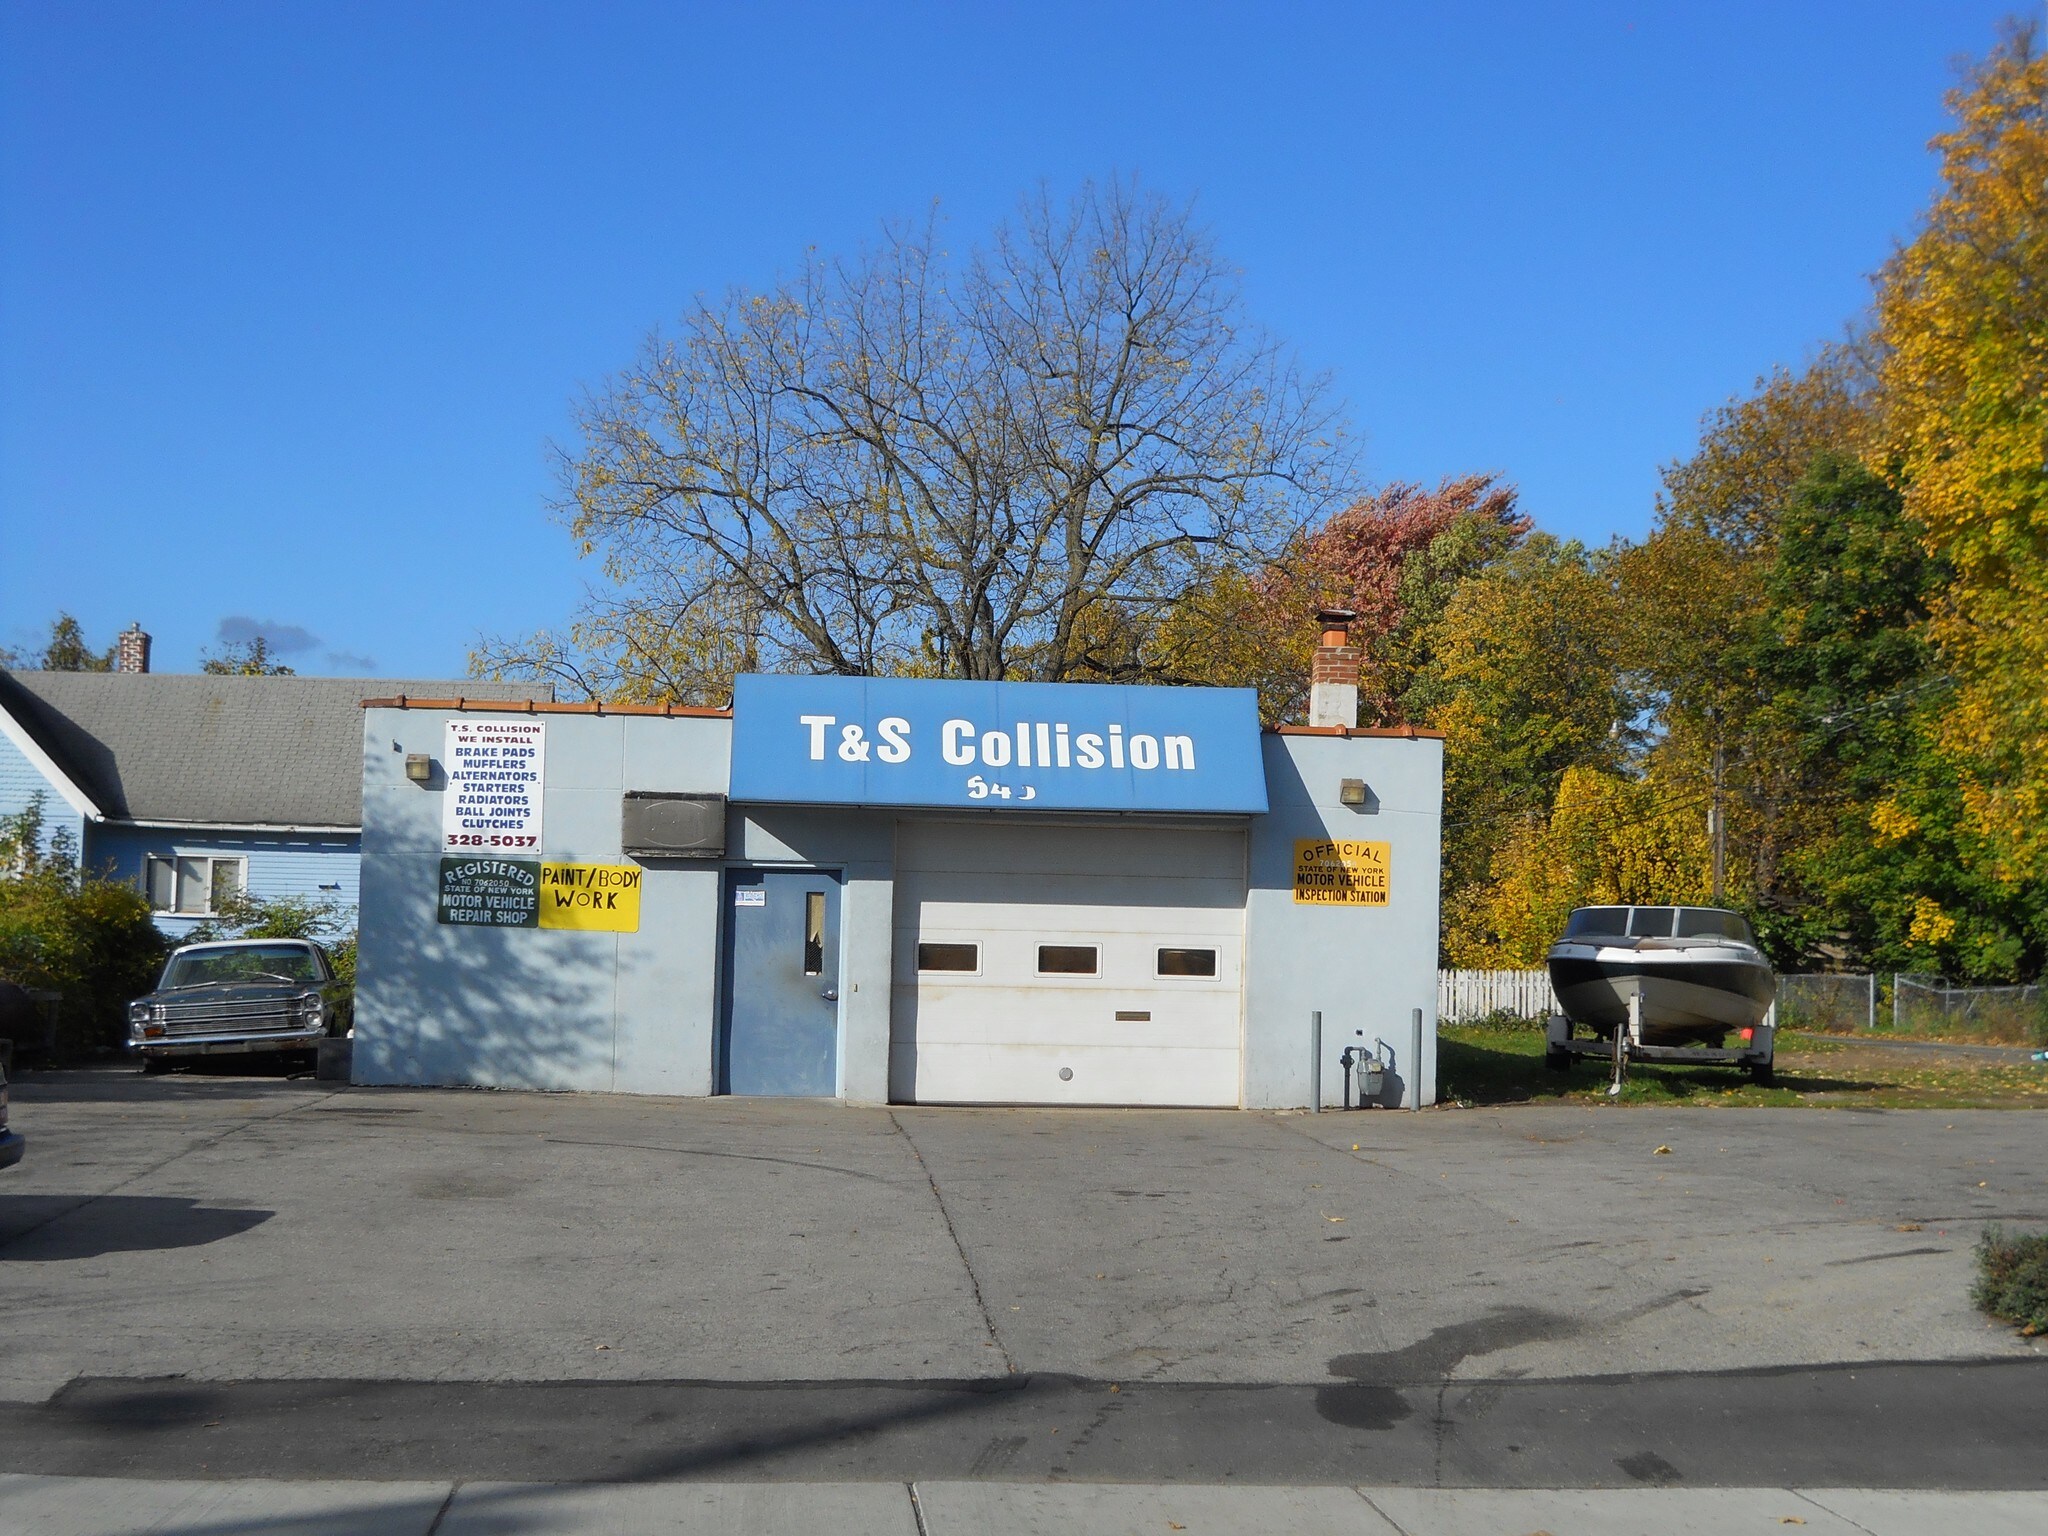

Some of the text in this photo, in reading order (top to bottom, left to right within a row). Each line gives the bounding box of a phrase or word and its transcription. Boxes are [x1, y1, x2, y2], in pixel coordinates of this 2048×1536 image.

[451, 724, 541, 734] T.S. COLLISION
[458, 735, 533, 744] WE INSTALL
[800, 714, 1196, 771] T&S Collision
[455, 747, 536, 758] BRAKE PADS
[463, 759, 527, 769] MUFFLERS
[452, 771, 538, 782] ALTERNATORS
[463, 782, 526, 793] STARTERS
[458, 795, 529, 805] RADIATORS
[455, 806, 531, 817] BALL JOINTS
[462, 818, 524, 829] CLUTCHES
[447, 834, 537, 847] 328-5037
[1303, 844, 1382, 864] OFFICIAL
[445, 860, 535, 886] REGISTERED
[1298, 865, 1324, 873] STATE
[1326, 865, 1338, 873] OF
[1340, 866, 1359, 874] NEW
[475, 879, 510, 888] 7062050
[1297, 873, 1385, 887] MOTOR VEHICLE
[444, 884, 535, 896] STATE OF NEW YORK
[1295, 888, 1386, 903] INSPECTION STATION
[442, 893, 535, 910] MOTOR VEHICLE
[555, 889, 618, 910] WORK
[450, 908, 528, 924] REPAIR SHOP
